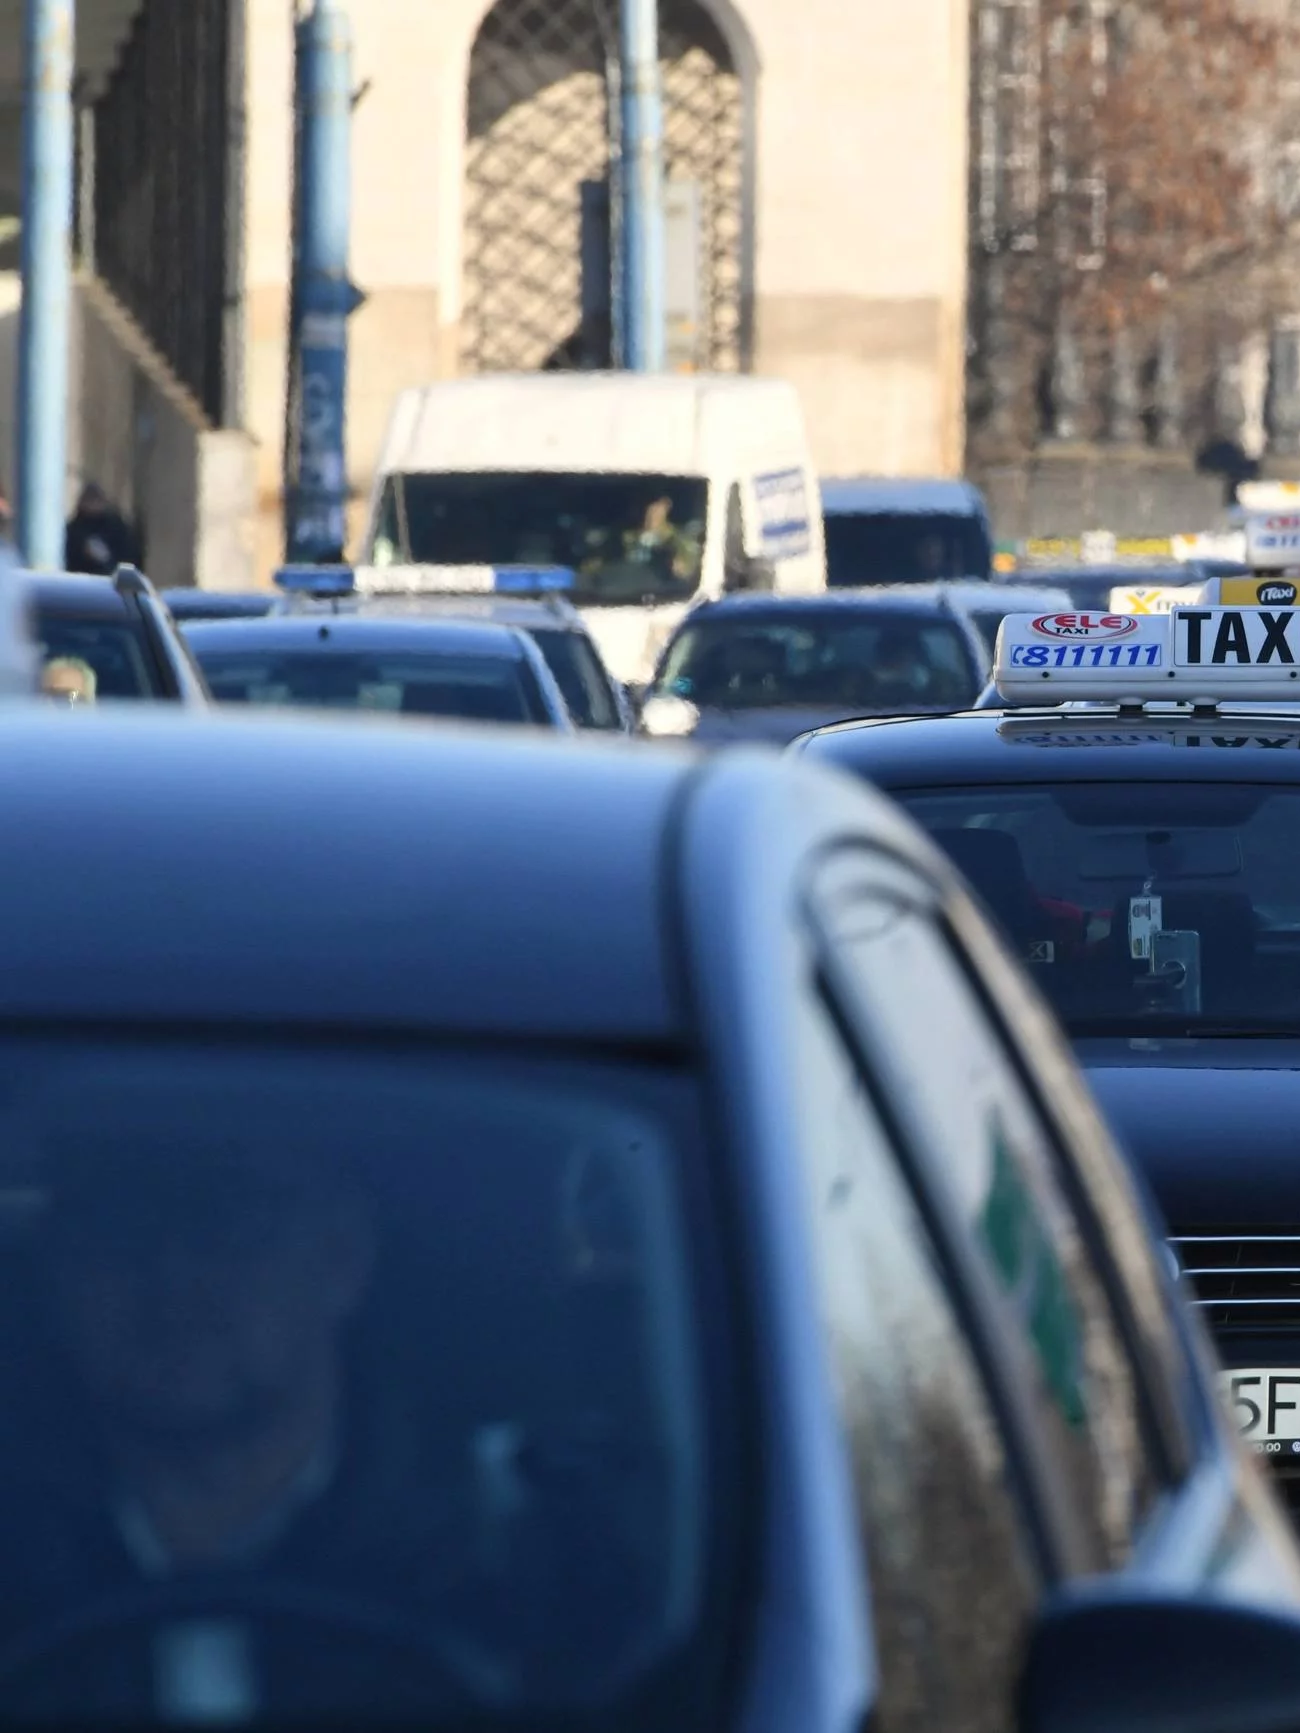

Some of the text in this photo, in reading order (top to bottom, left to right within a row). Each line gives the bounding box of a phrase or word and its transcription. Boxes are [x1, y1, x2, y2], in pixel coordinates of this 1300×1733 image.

[1054, 615, 1122, 629] ELE
[1054, 627, 1089, 635] TAXI
[1022, 645, 1159, 666] 8111111
